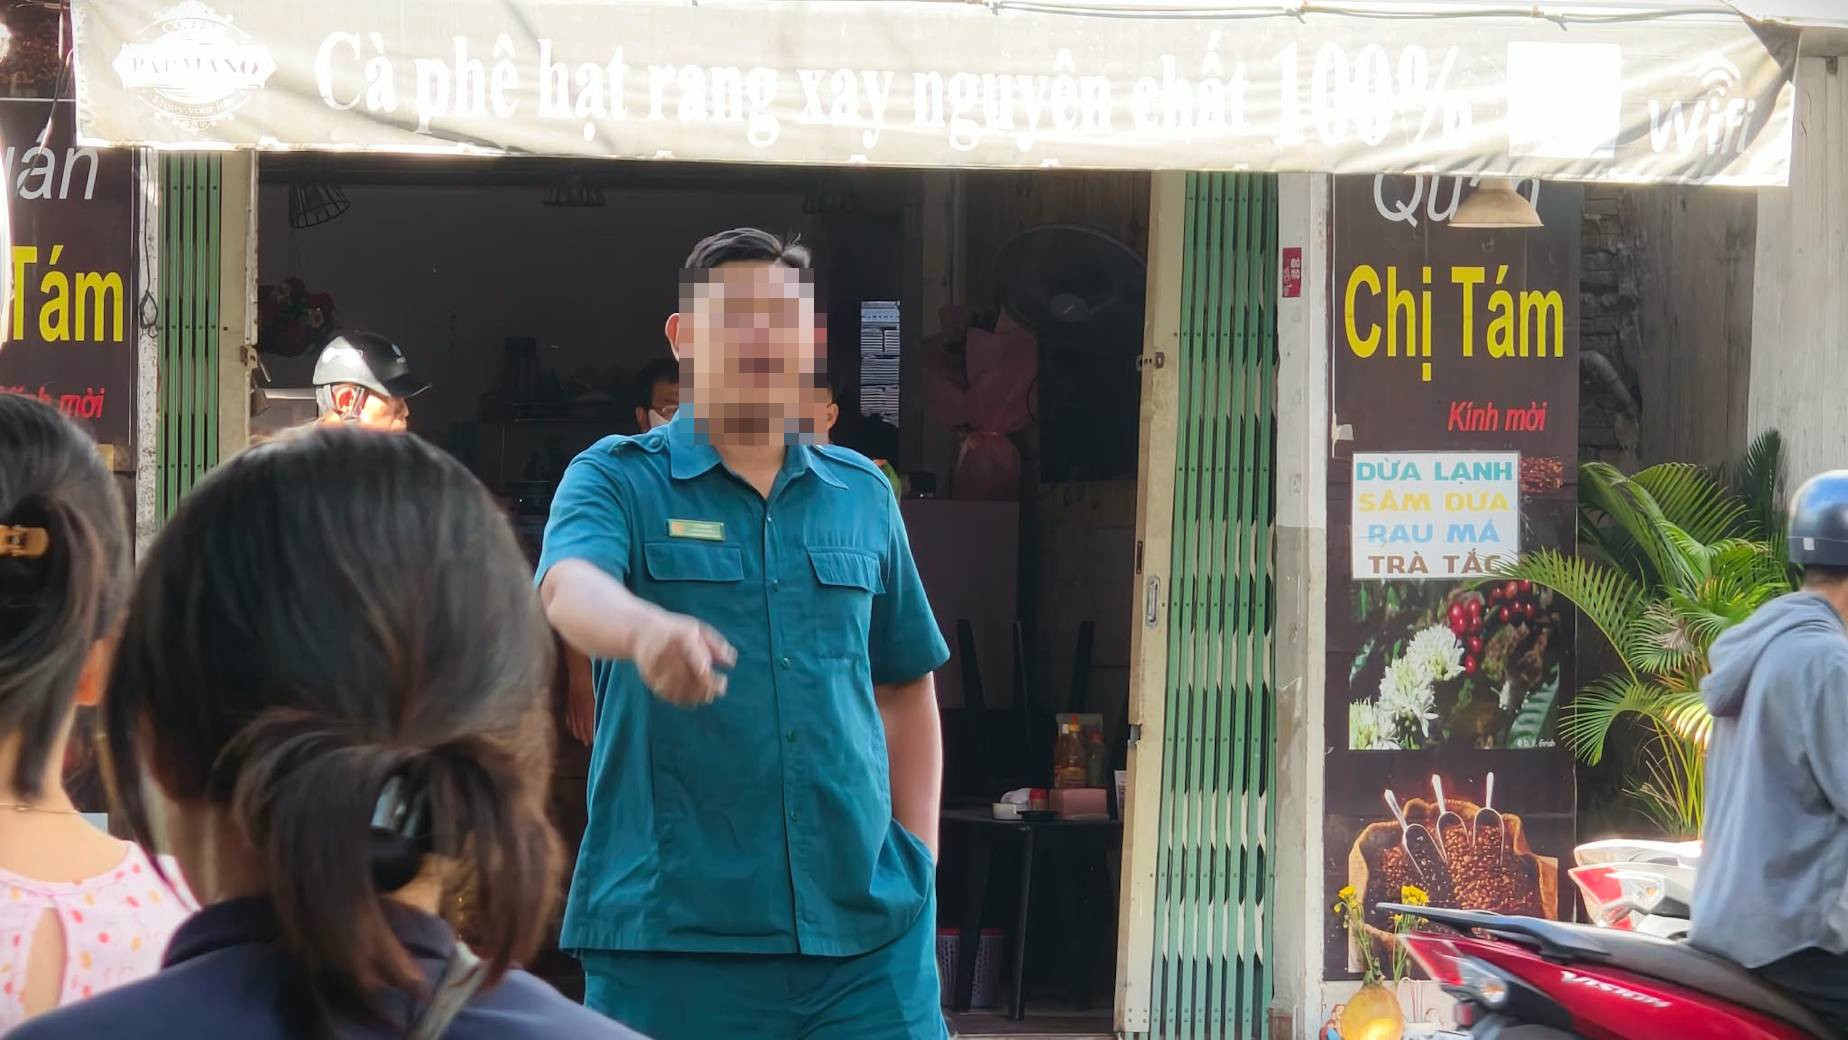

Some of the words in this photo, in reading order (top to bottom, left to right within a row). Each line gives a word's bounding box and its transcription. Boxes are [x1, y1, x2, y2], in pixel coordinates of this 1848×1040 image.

[315, 31, 400, 112] Cà
[415, 34, 521, 134] phê
[537, 37, 630, 142] hạt
[647, 62, 781, 148] rang
[796, 66, 895, 150] xay
[911, 47, 1112, 152] nguyên
[1132, 29, 1251, 131] chất
[1272, 40, 1474, 148] 100%
[1648, 97, 1755, 154] Wifi
[1373, 173, 1540, 227] Qun
[11, 245, 124, 341] Tám
[1344, 264, 1432, 382] Chị
[1451, 264, 1564, 359] Tám
[1447, 400, 1499, 431] Kính
[1504, 400, 1548, 431] mời
[1356, 457, 1422, 481] DỪA
[1434, 461, 1513, 485] LẠNH
[1368, 523, 1433, 543] RAU
[1447, 519, 1500, 543] MÁ
[1368, 550, 1429, 574] TRÀ
[1560, 970, 1673, 1008] VISION
